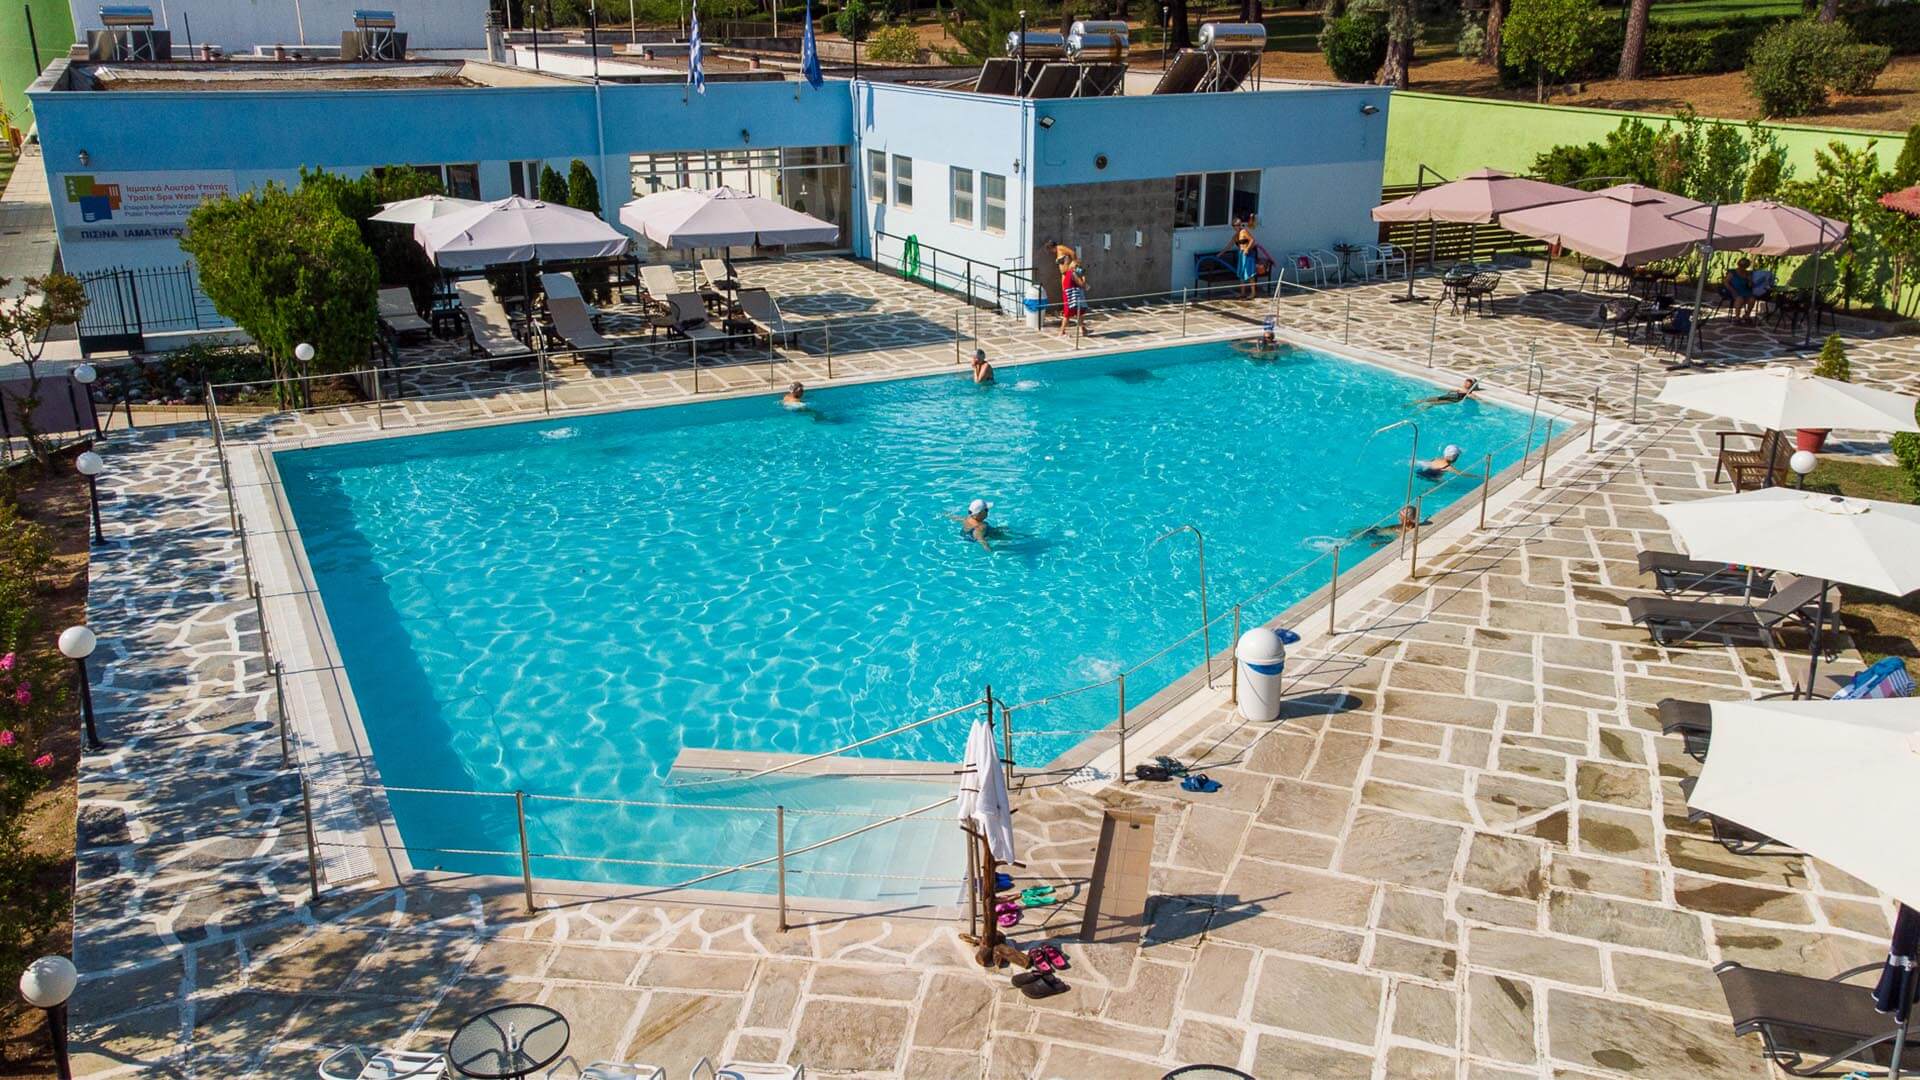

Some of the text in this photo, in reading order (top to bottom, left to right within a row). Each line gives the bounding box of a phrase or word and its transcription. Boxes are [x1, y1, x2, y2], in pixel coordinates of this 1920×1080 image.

[197, 183, 229, 191] Υπάτης
[156, 193, 173, 201] Spa
[175, 192, 198, 200] Water
[81, 227, 183, 239] ΠΙΣΙΝΑ ΙΑΜΑΤΙΚΟΥ
